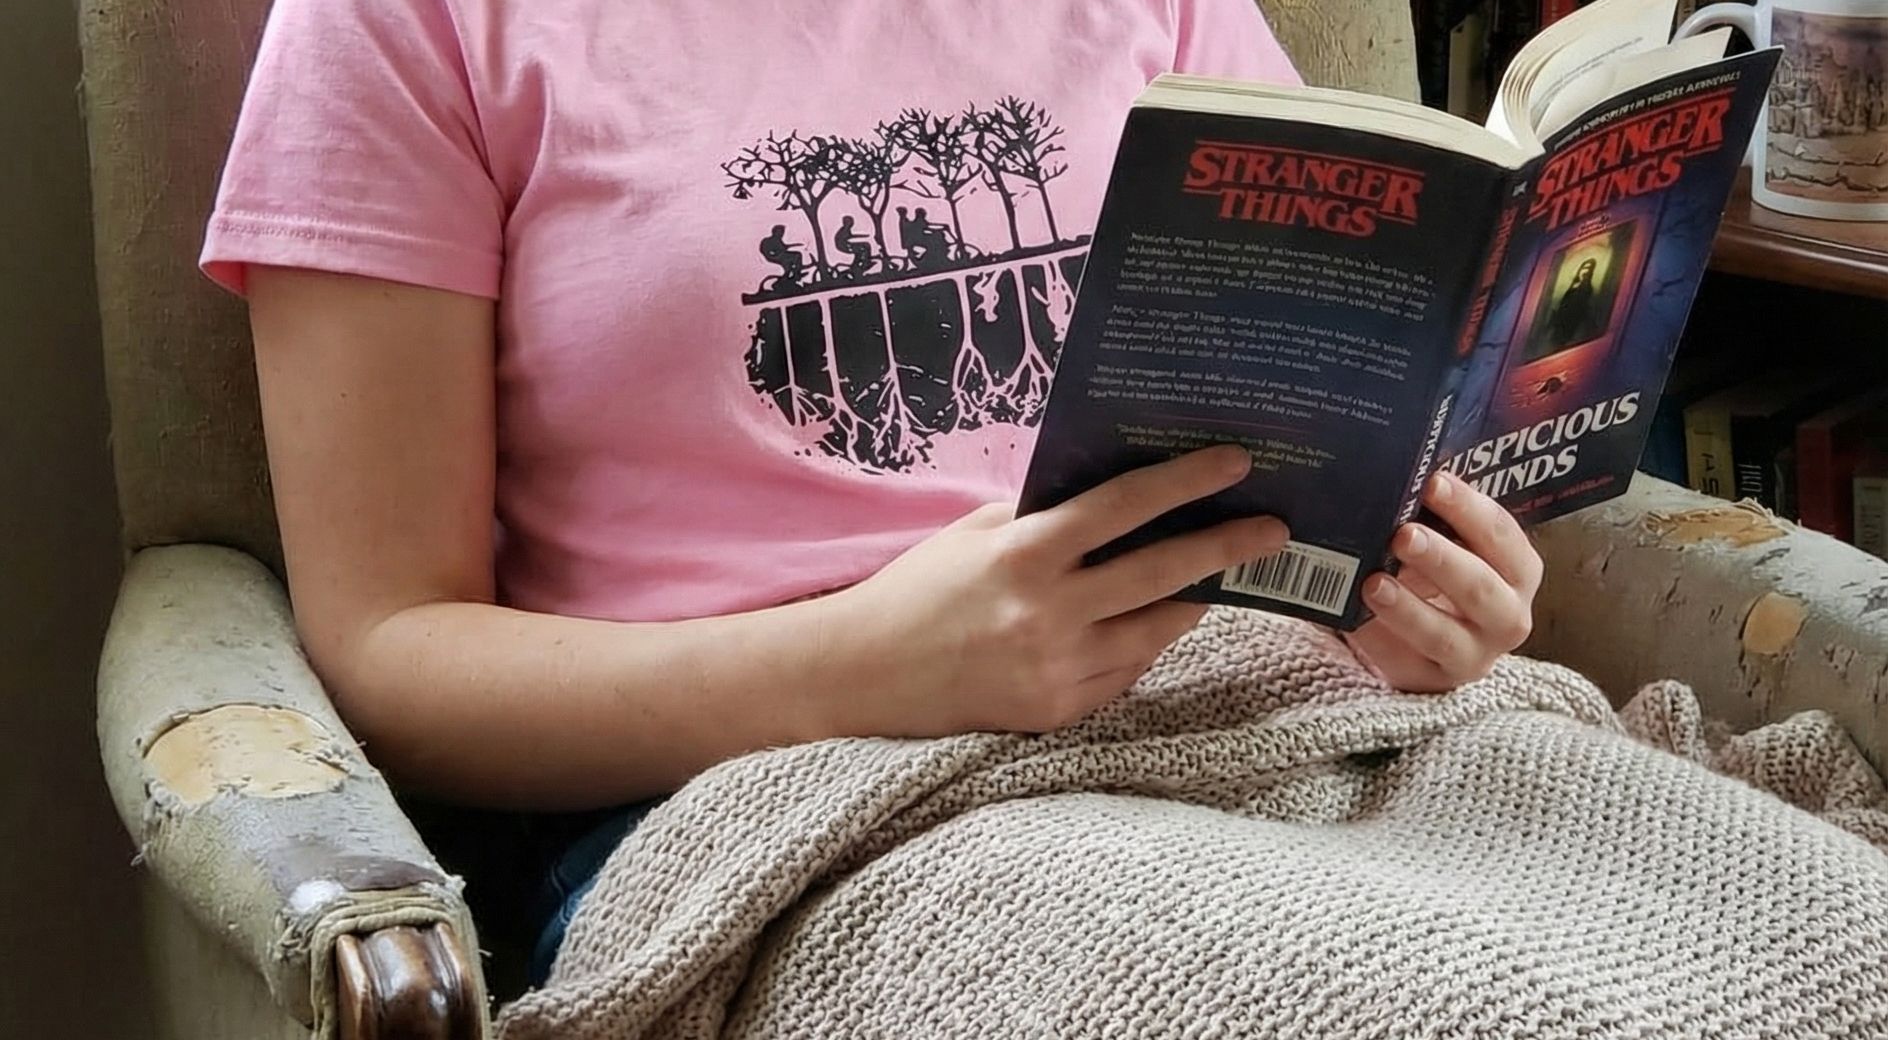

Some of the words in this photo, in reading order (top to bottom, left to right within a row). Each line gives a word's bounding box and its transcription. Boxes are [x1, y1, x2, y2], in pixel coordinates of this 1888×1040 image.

[1183, 145, 1425, 220] STRANGER
[1529, 94, 1732, 215] STRANGER
[1546, 150, 1685, 231] THINGS
[1218, 187, 1378, 238] THINGS
